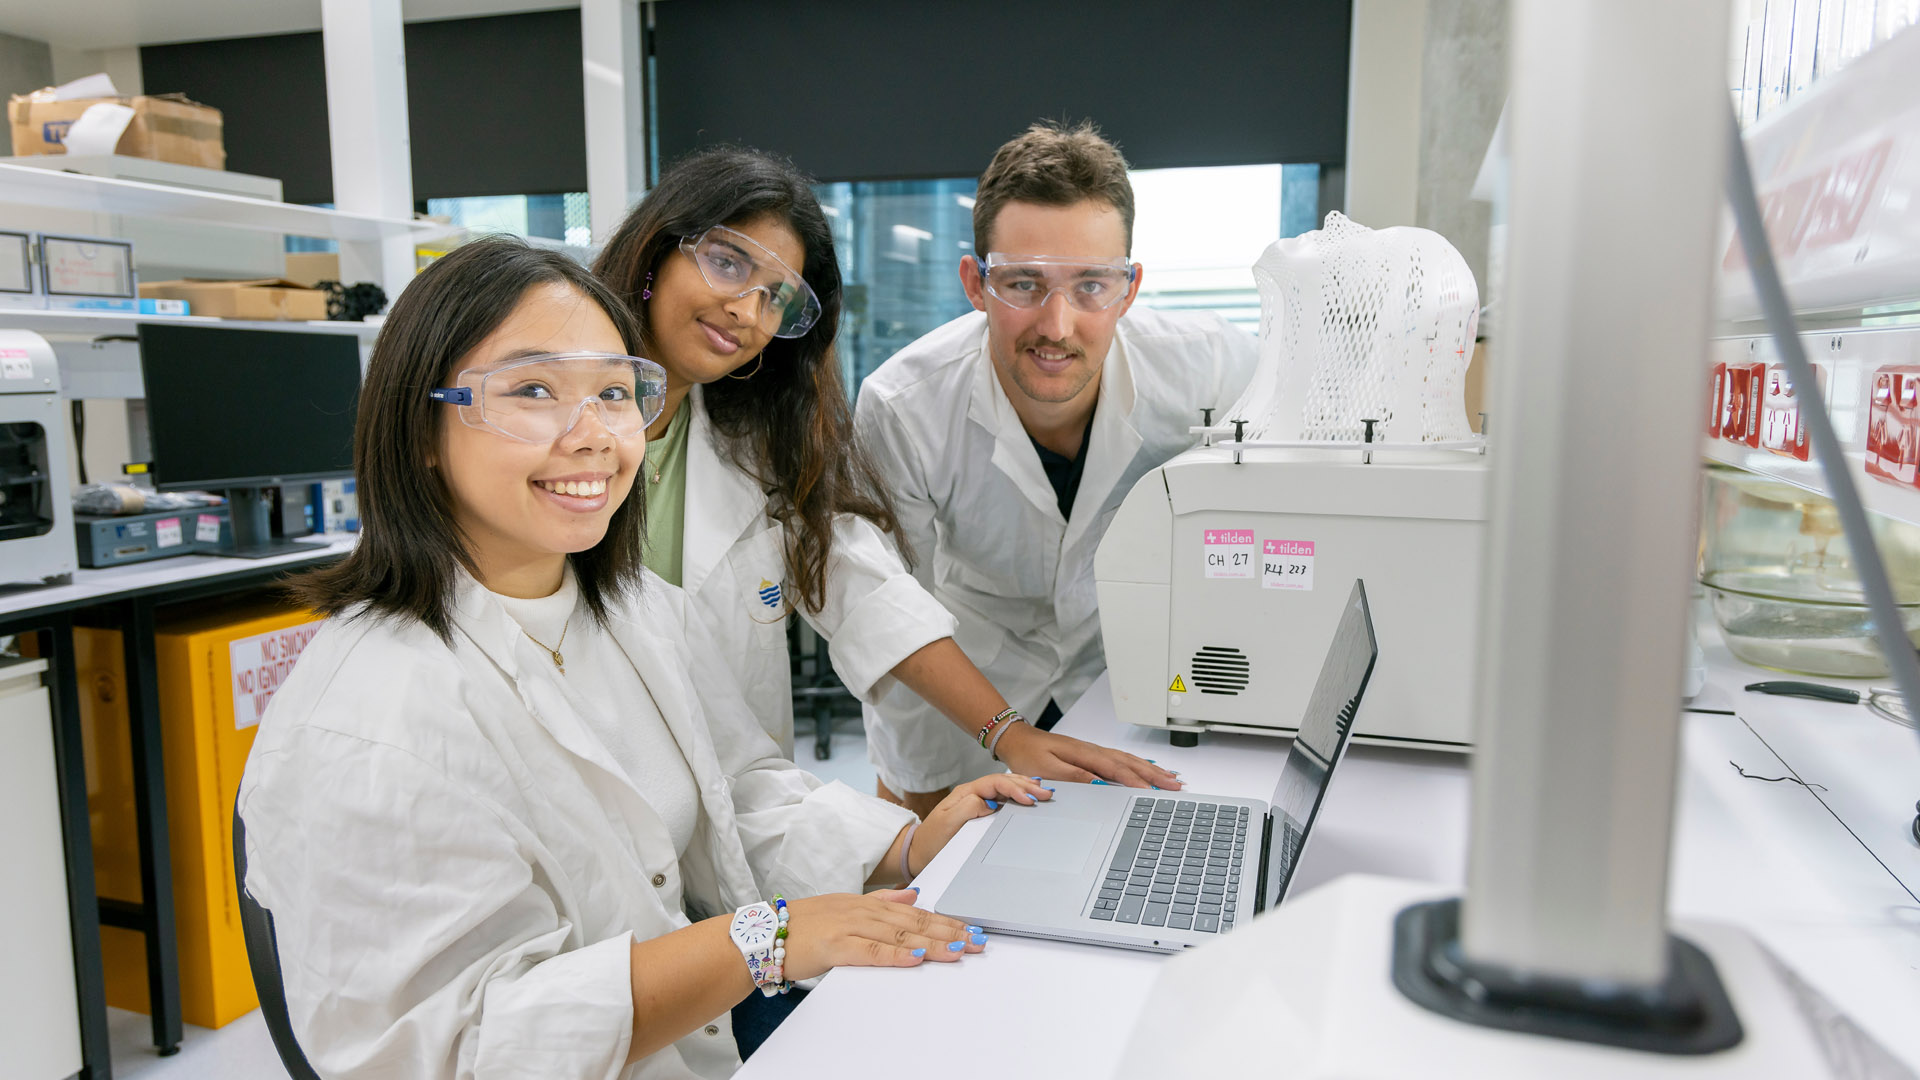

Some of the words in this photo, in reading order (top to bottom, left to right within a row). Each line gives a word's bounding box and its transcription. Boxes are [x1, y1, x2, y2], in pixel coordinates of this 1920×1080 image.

[1220, 532, 1252, 543] tilden
[1279, 542, 1312, 555] tilden
[1208, 553, 1225, 566] CH
[1232, 552, 1248, 566] 27
[1288, 564, 1307, 575] 223
[261, 637, 279, 663] NO
[237, 669, 255, 696] NO
